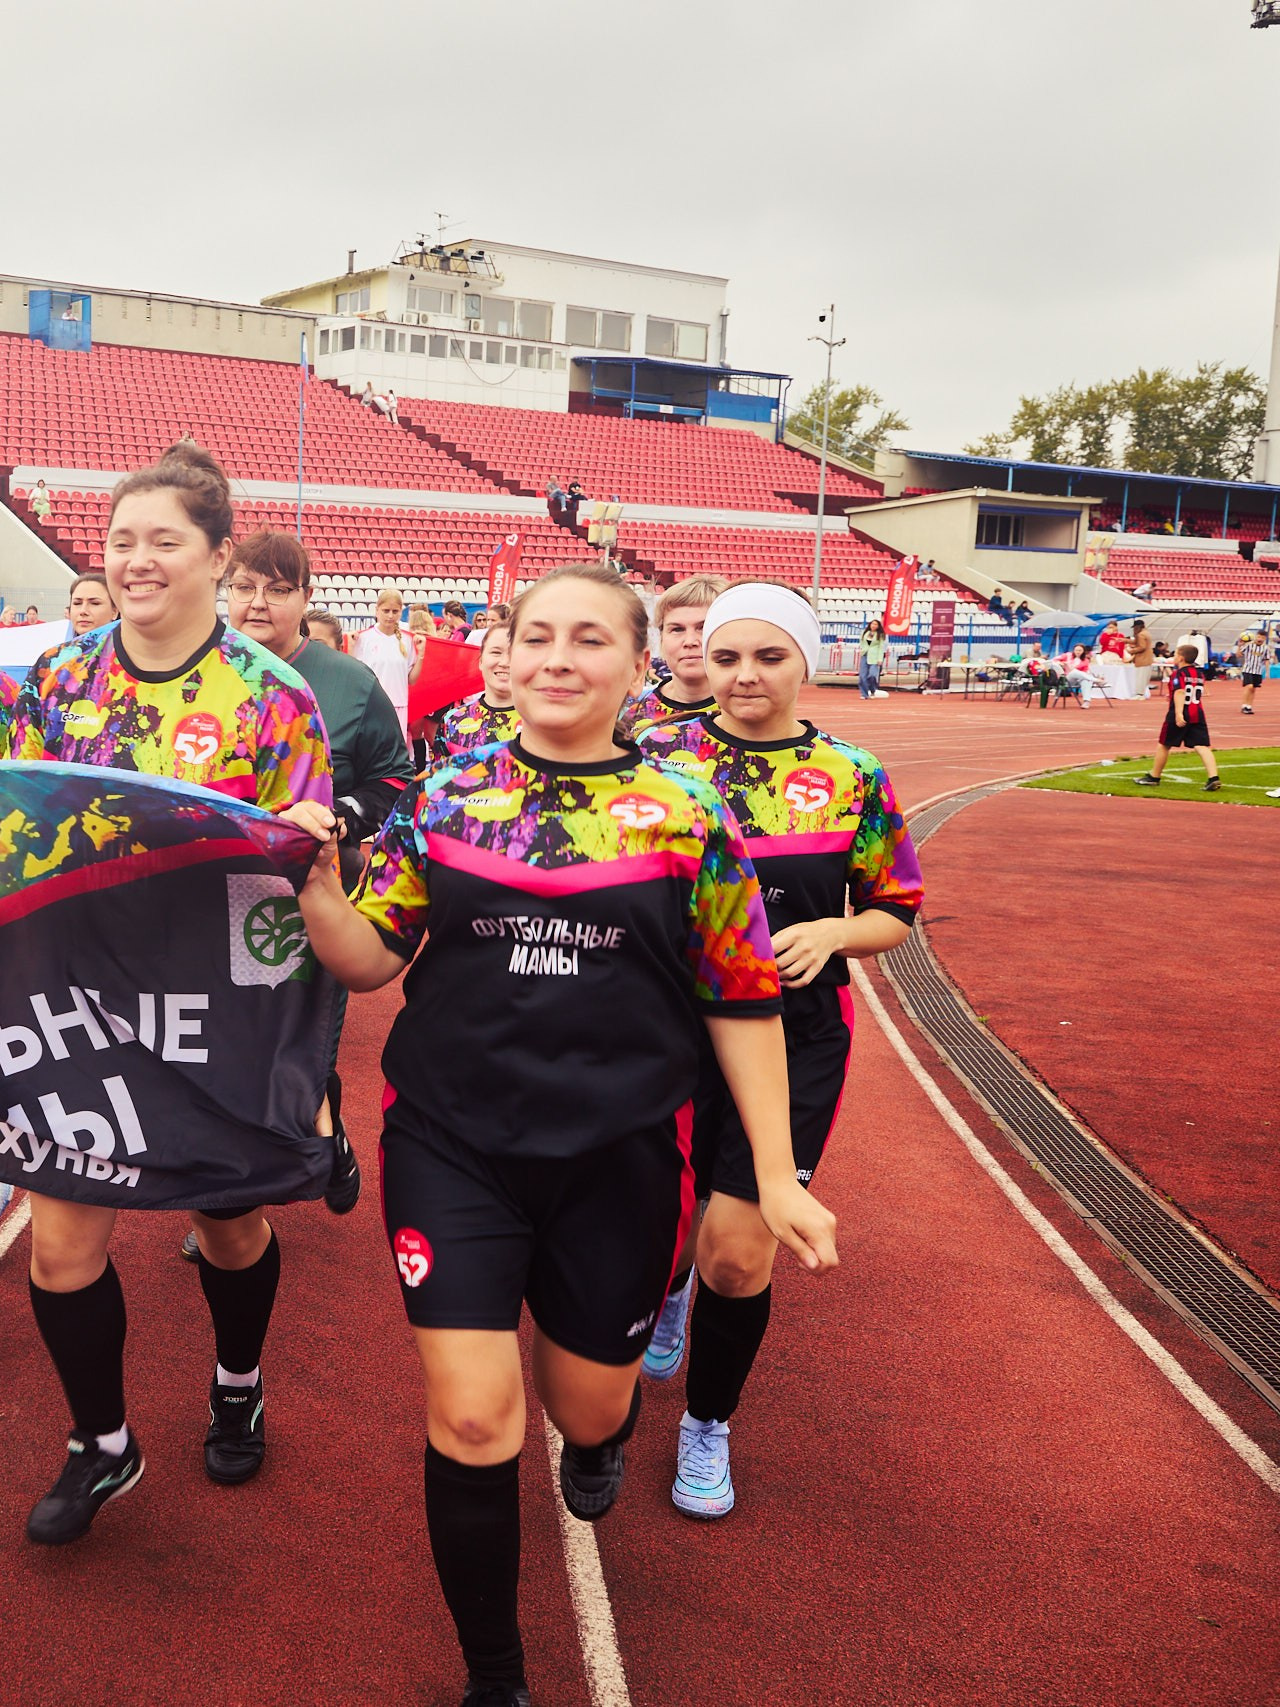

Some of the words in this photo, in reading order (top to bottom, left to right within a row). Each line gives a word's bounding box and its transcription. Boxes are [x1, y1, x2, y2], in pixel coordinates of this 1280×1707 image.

[890, 577, 905, 618] ОСНОВА
[174, 732, 219, 765] 52
[784, 783, 830, 813] 52
[609, 804, 667, 829] 52
[472, 915, 626, 949] ФУТБОЛЬНЫЕ
[508, 943, 579, 976] МАМЫ
[397, 1251, 429, 1288] 52
